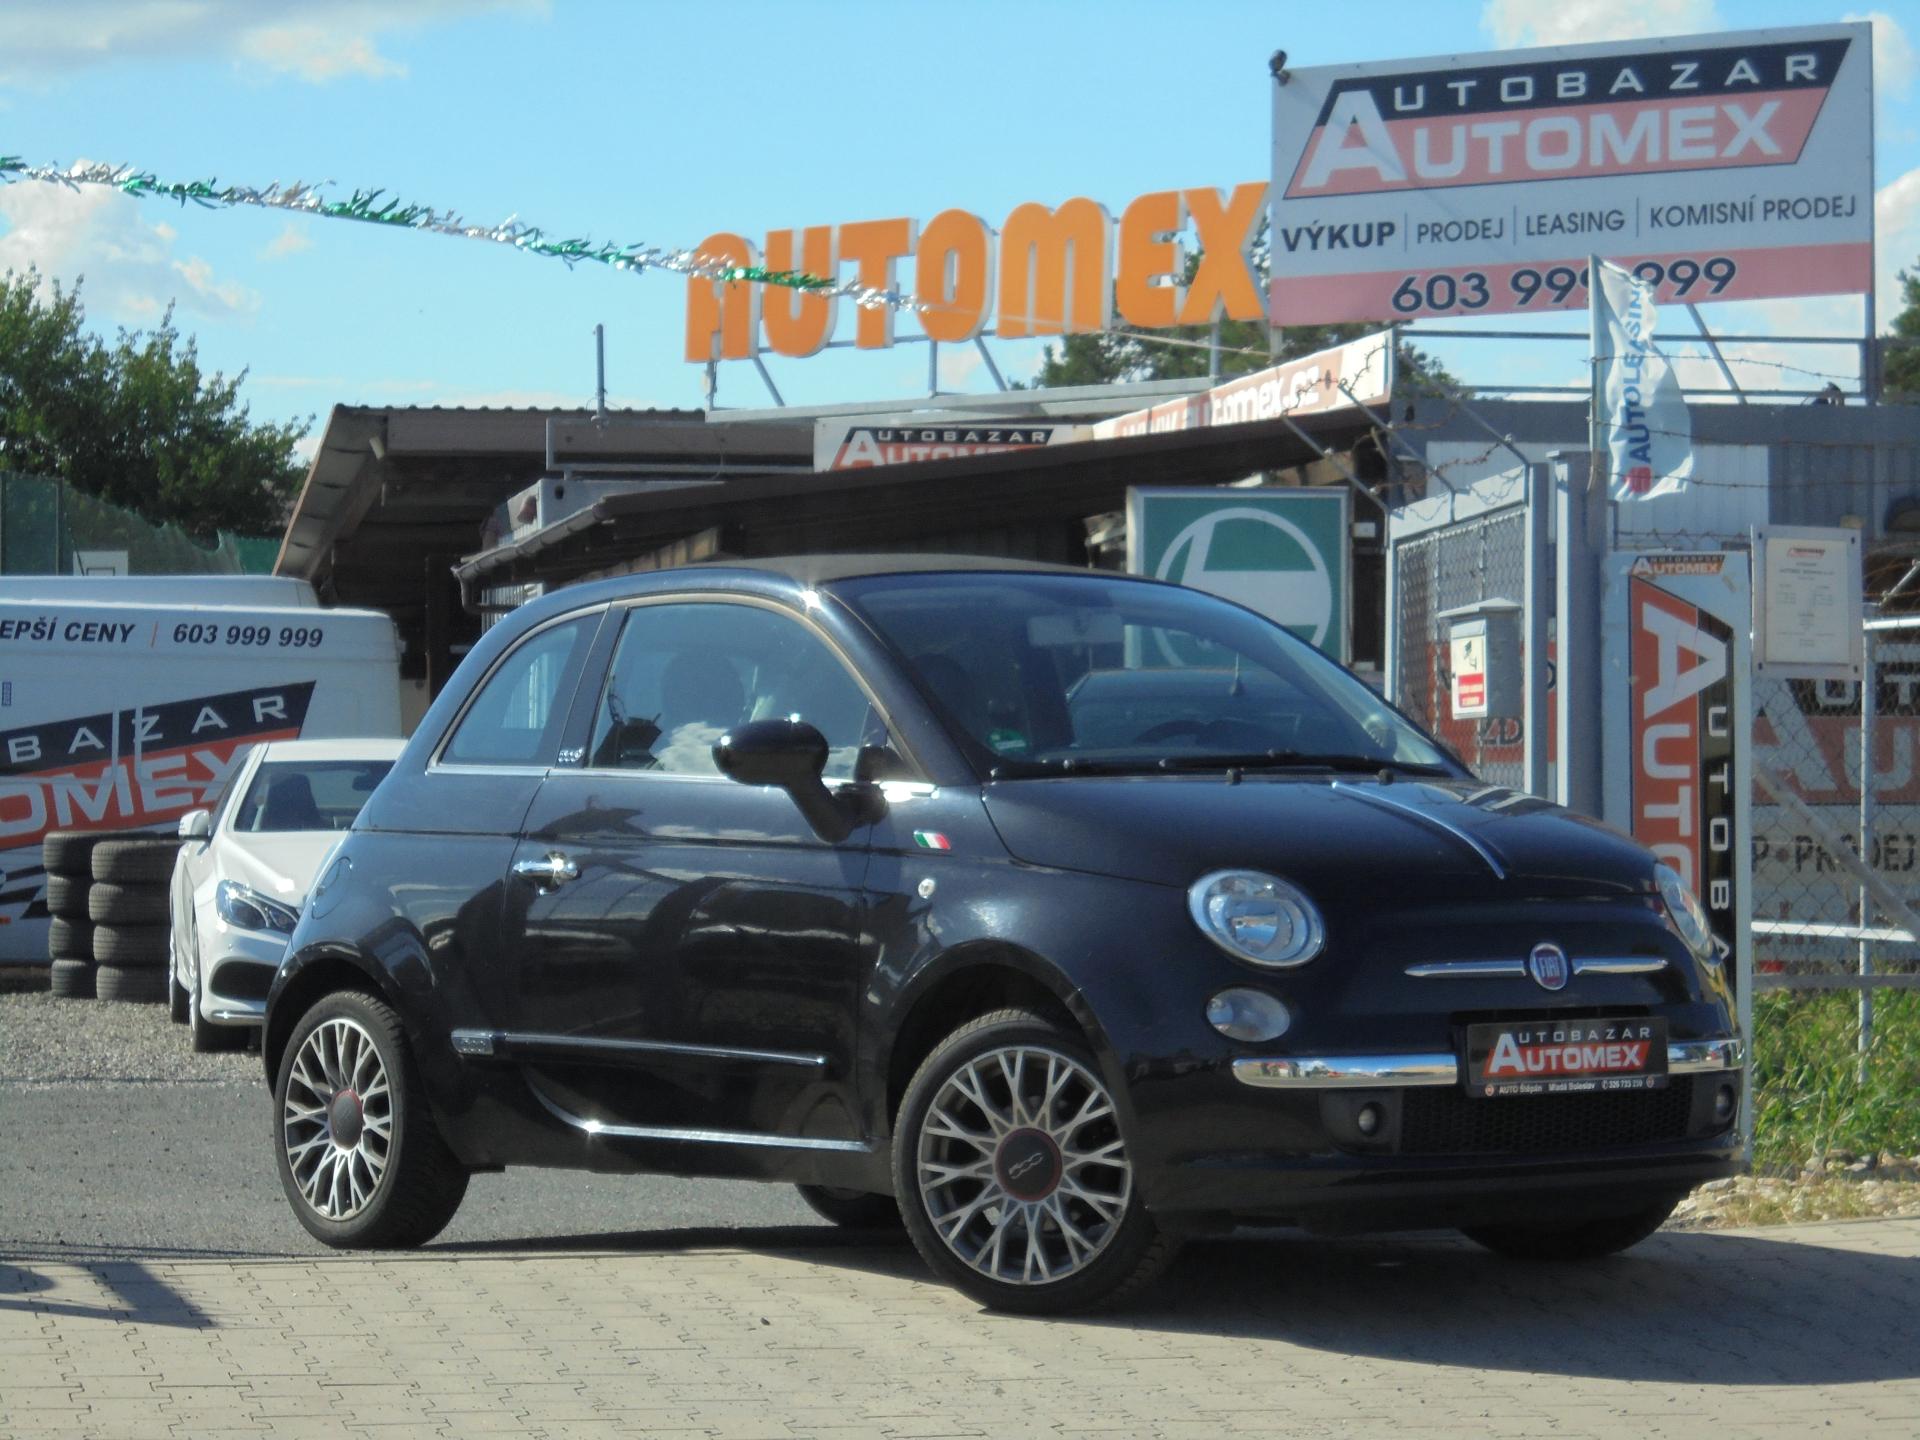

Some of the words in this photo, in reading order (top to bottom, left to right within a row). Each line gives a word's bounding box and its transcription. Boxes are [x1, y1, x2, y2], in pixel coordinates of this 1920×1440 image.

[1300, 90, 1781, 189] AUTOMEX
[1282, 220, 1396, 252] VÝKUP
[1417, 218, 1504, 244] PRODEJ
[1526, 210, 1625, 237] LEASING
[1651, 194, 1756, 228] KOMISNÍ
[1764, 195, 1855, 221] PRODEJ
[685, 181, 1270, 363] AUTOMEX
[1392, 272, 1490, 313] 603
[1511, 267, 1589, 306] 99
[1632, 557, 1718, 575] AUTOMEX
[64, 619, 135, 643] CENY
[173, 623, 218, 644] 603
[225, 625, 271, 646] 999
[278, 627, 323, 648] 999
[8, 694, 287, 765] BAZAR
[1489, 1032, 1641, 1073] AUTOMEX
